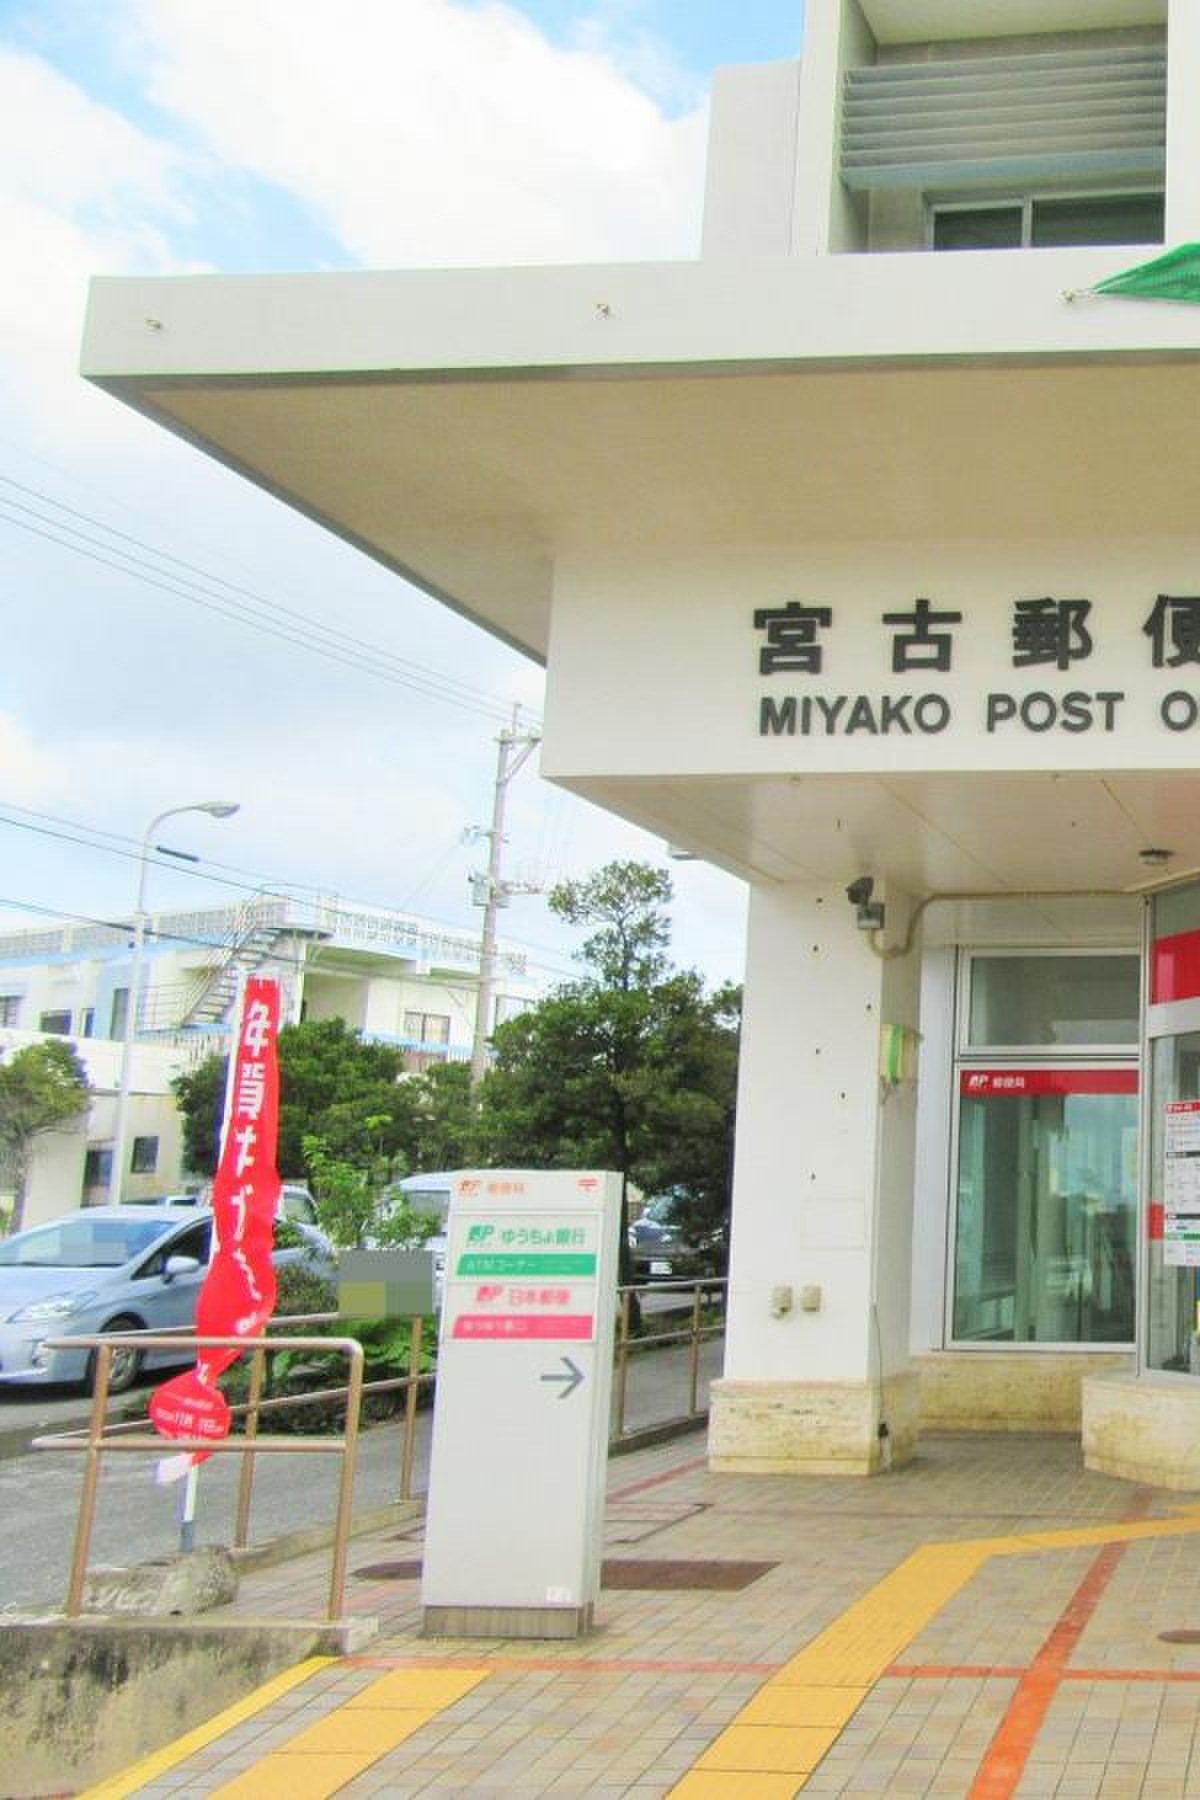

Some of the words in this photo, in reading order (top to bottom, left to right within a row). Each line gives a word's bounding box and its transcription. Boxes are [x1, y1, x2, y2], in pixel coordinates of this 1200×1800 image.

[758, 693, 951, 736] MIYAKO
[986, 691, 1125, 733] POST
[501, 1228, 586, 1245] ゆうちょ銀行
